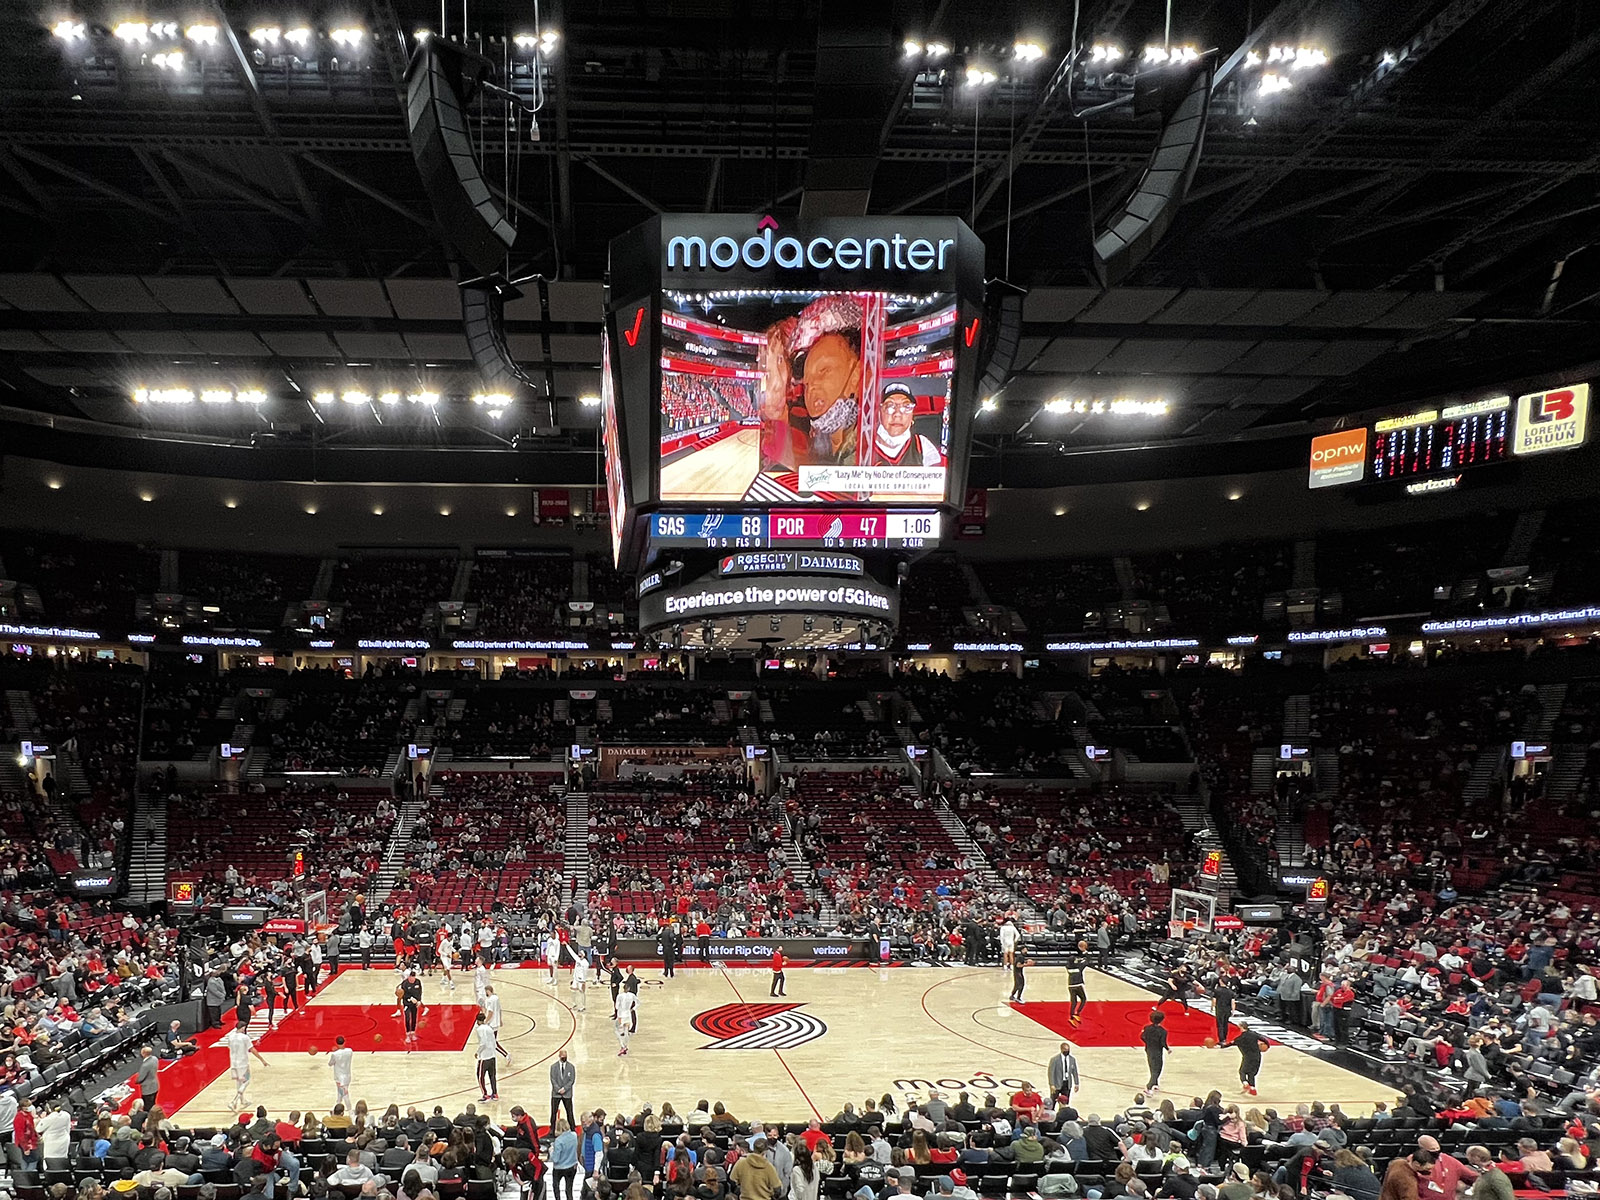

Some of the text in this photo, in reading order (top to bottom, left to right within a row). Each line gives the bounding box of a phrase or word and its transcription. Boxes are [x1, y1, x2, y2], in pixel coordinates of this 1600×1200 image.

[1525, 421, 1576, 437] LORENTZ
[1524, 430, 1576, 446] BRUUN
[1312, 443, 1364, 463] opnw
[864, 470, 873, 480] by
[882, 470, 894, 479] One
[895, 470, 901, 479] of
[902, 470, 943, 480] Consequence
[1407, 477, 1456, 493] verizon
[658, 516, 761, 536] SAS 68
[777, 517, 878, 536] POR 47
[903, 518, 931, 534] 1:06
[707, 537, 761, 548] TO 5 FLS 0
[824, 537, 878, 548] TO 5 FLS 0
[743, 562, 787, 571] PARTNERS
[801, 556, 861, 571] DAIMLER
[665, 586, 890, 614] Experience the power of 5G here.
[1421, 621, 1455, 631] Official
[1455, 619, 1471, 628] 5G
[1471, 617, 1508, 629] partner
[1508, 616, 1520, 625] of
[1521, 614, 1540, 623] The
[1540, 609, 1587, 622] Portland
[4, 625, 20, 633] The
[20, 625, 53, 636] Portland
[607, 748, 647, 756] DAIMLER
[1203, 859, 1219, 875] 24
[75, 877, 109, 887] verizon
[1311, 888, 1323, 897] 24
[719, 945, 734, 955] for
[734, 945, 751, 957] Rip
[752, 945, 774, 957] City.
[813, 946, 848, 955] verizon
[893, 1075, 1036, 1090] moda
